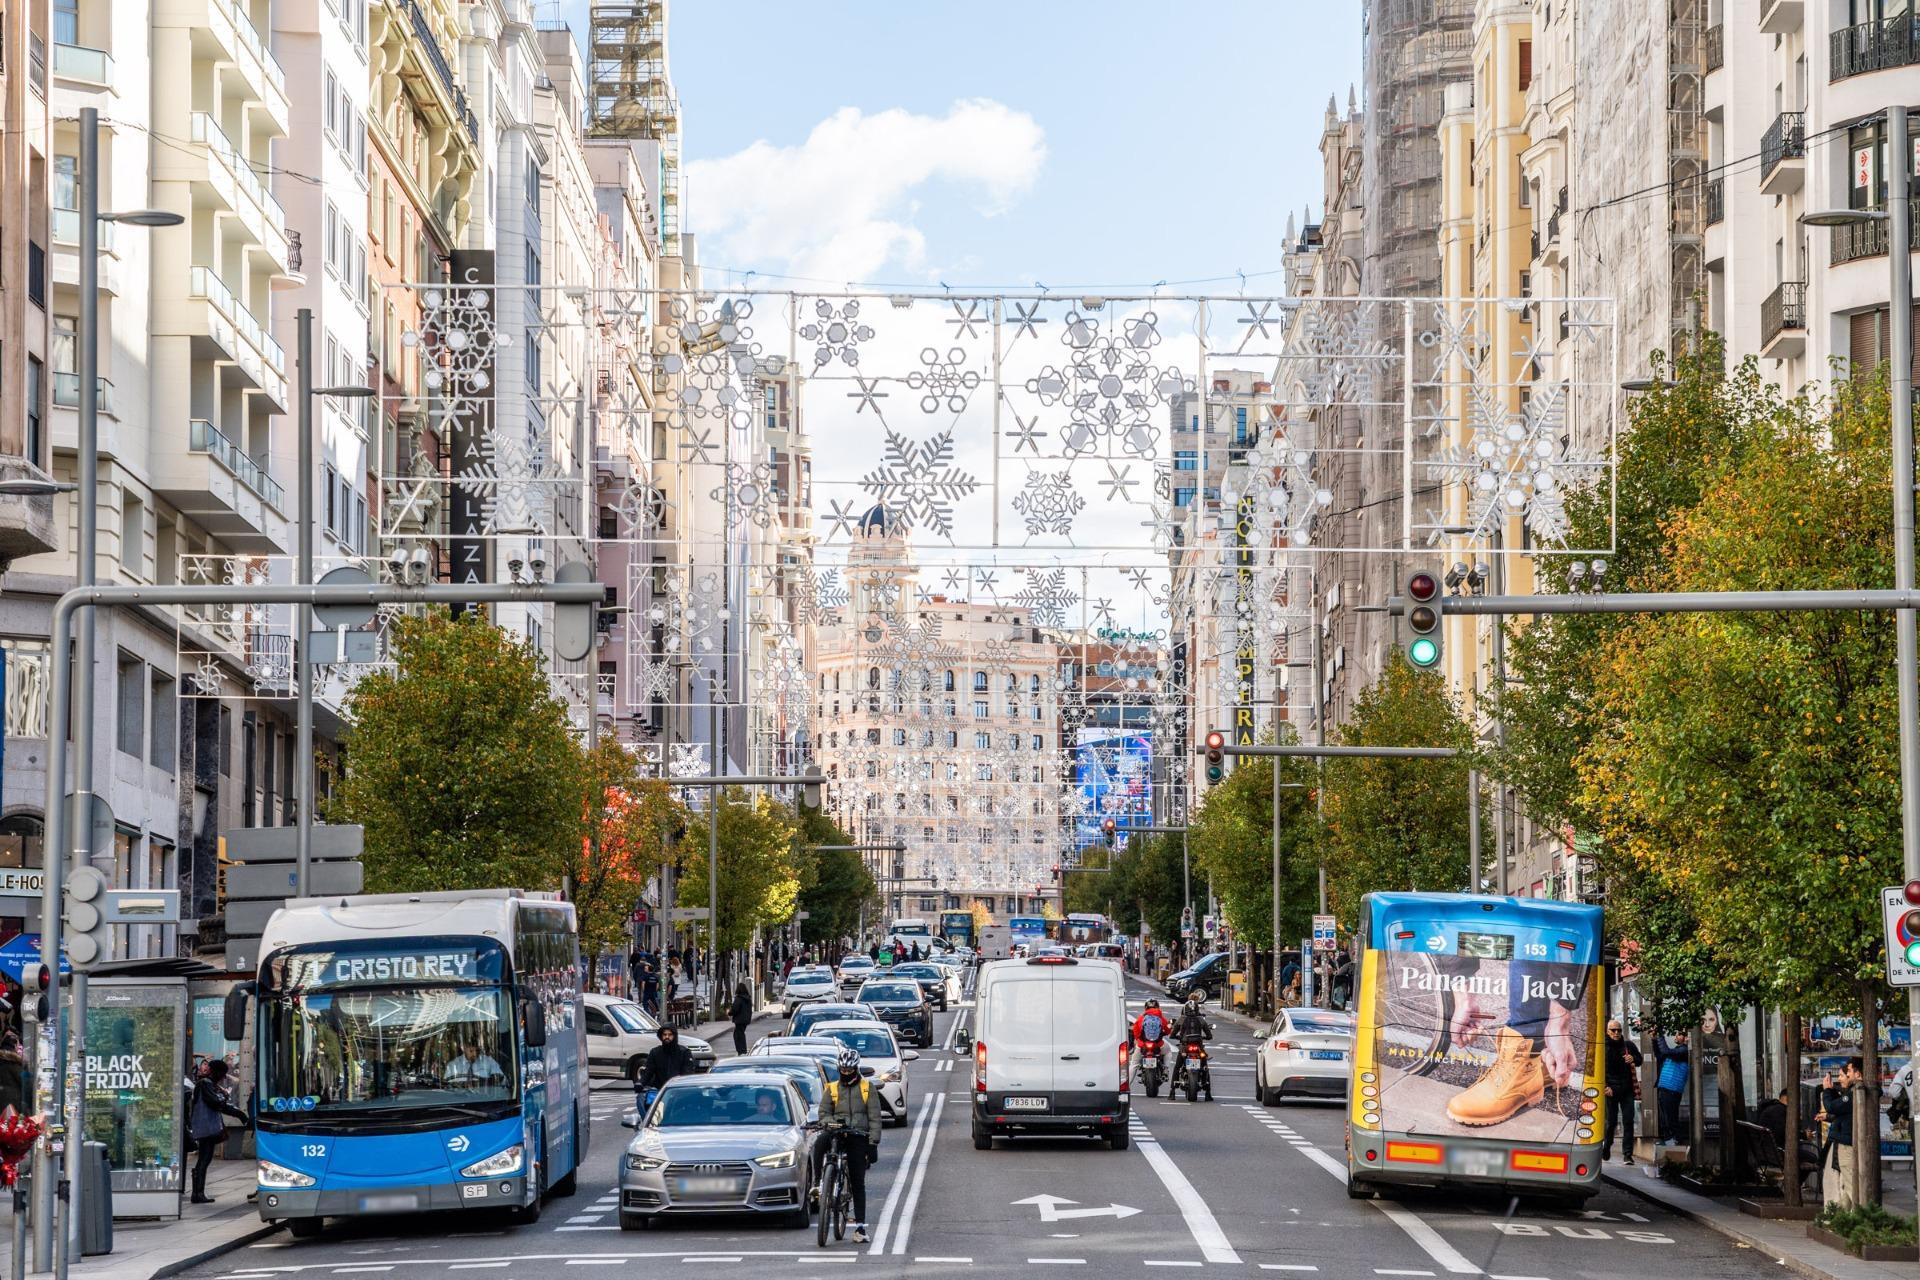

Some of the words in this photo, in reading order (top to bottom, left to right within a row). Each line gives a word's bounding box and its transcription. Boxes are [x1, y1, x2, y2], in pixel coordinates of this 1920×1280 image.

[1889, 898, 1903, 906] EN
[1477, 935, 1496, 957] 3
[1523, 943, 1548, 956] 153
[335, 956, 417, 981] CRISTO
[424, 954, 468, 978] REY
[1400, 966, 1507, 996] Panama
[1521, 974, 1577, 1003] Jack
[1388, 1047, 1424, 1058] MADE
[85, 1055, 144, 1072] BLACK
[1424, 1056, 1455, 1065] SINCE
[85, 1072, 152, 1089] FRIDAY
[1010, 1098, 1029, 1106] 7836
[301, 1144, 326, 1157] 132
[466, 1186, 484, 1197] SP
[1491, 1222, 1676, 1244] BUS
